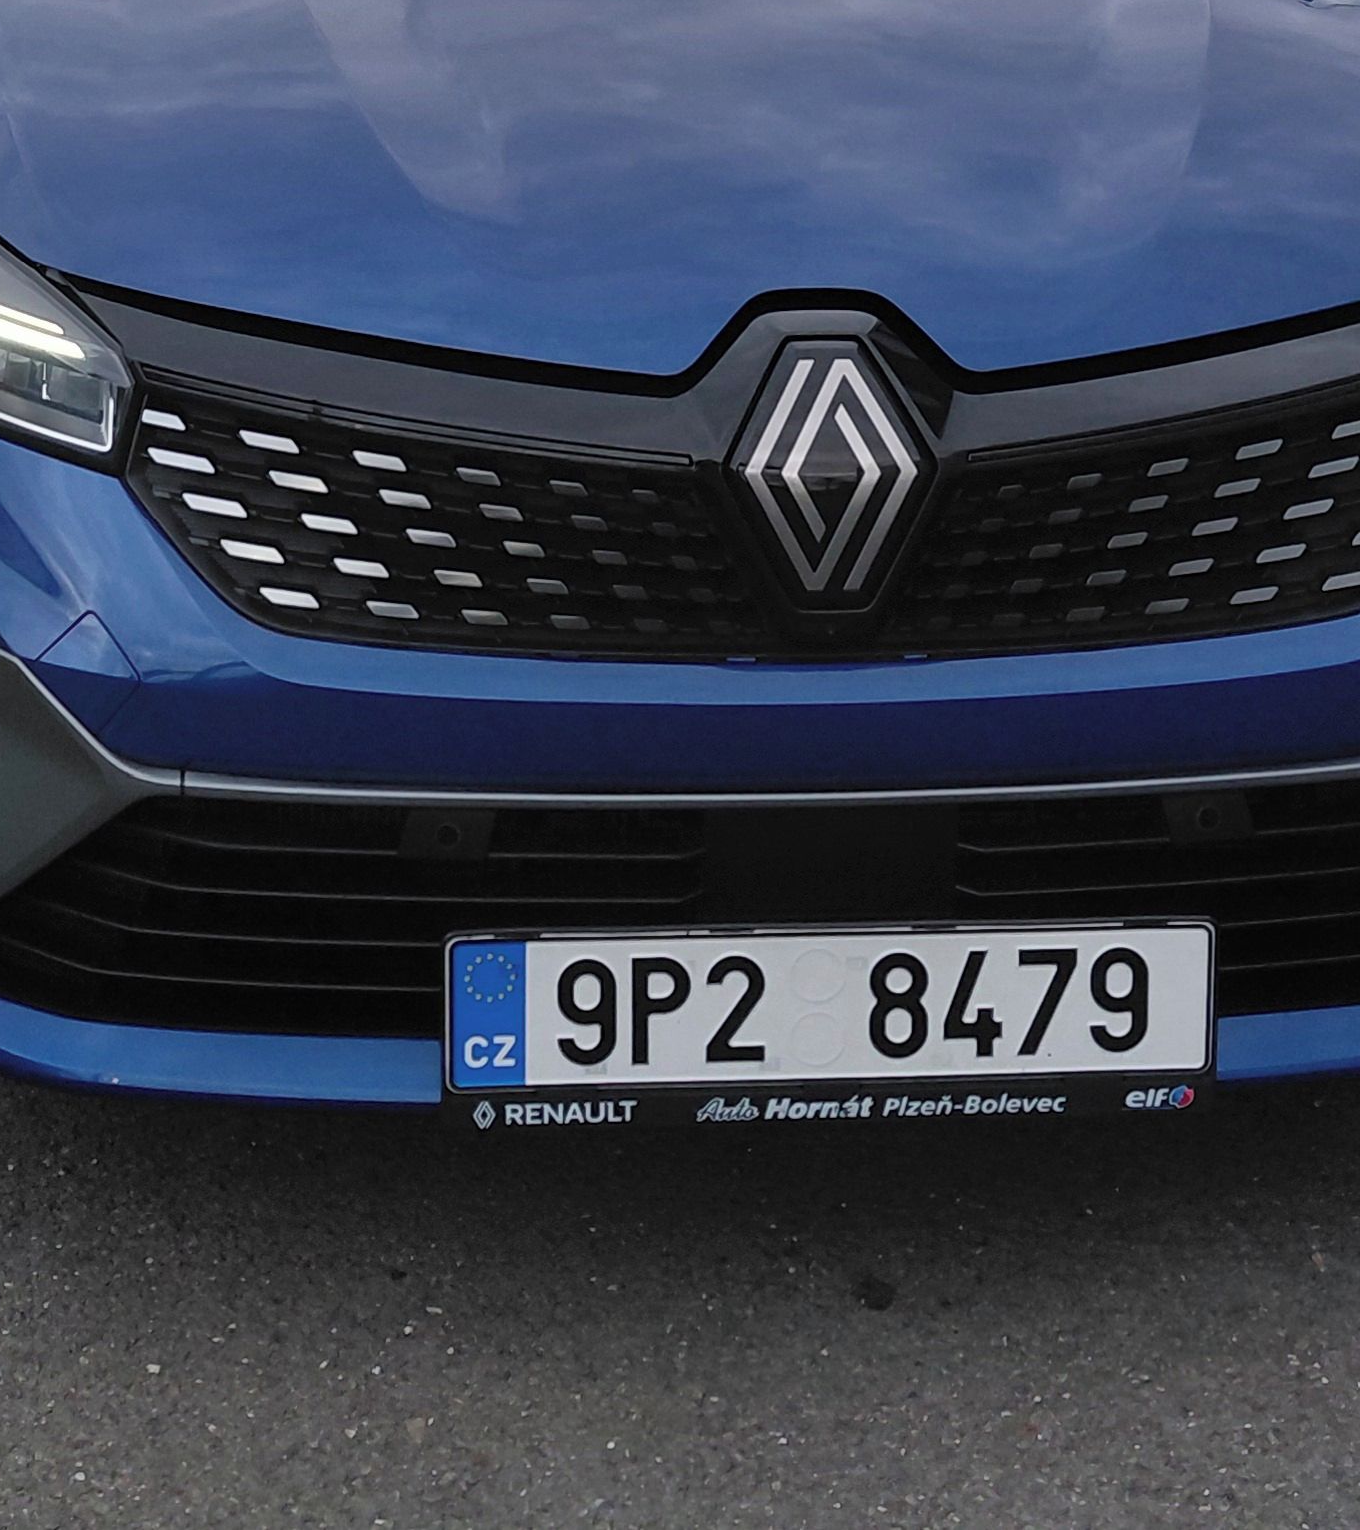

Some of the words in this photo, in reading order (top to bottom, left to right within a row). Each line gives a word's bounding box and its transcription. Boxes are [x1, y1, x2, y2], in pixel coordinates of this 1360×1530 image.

[557, 957, 766, 1066] 9P2
[868, 947, 1150, 1058] 8479
[464, 1035, 516, 1068] CZ
[504, 1100, 638, 1126] RENAULT
[697, 1097, 760, 1123] Auto
[764, 1095, 872, 1120] Hornát
[883, 1093, 1067, 1118] Plzeň-Bolevec
[1124, 1090, 1170, 1109] elf
